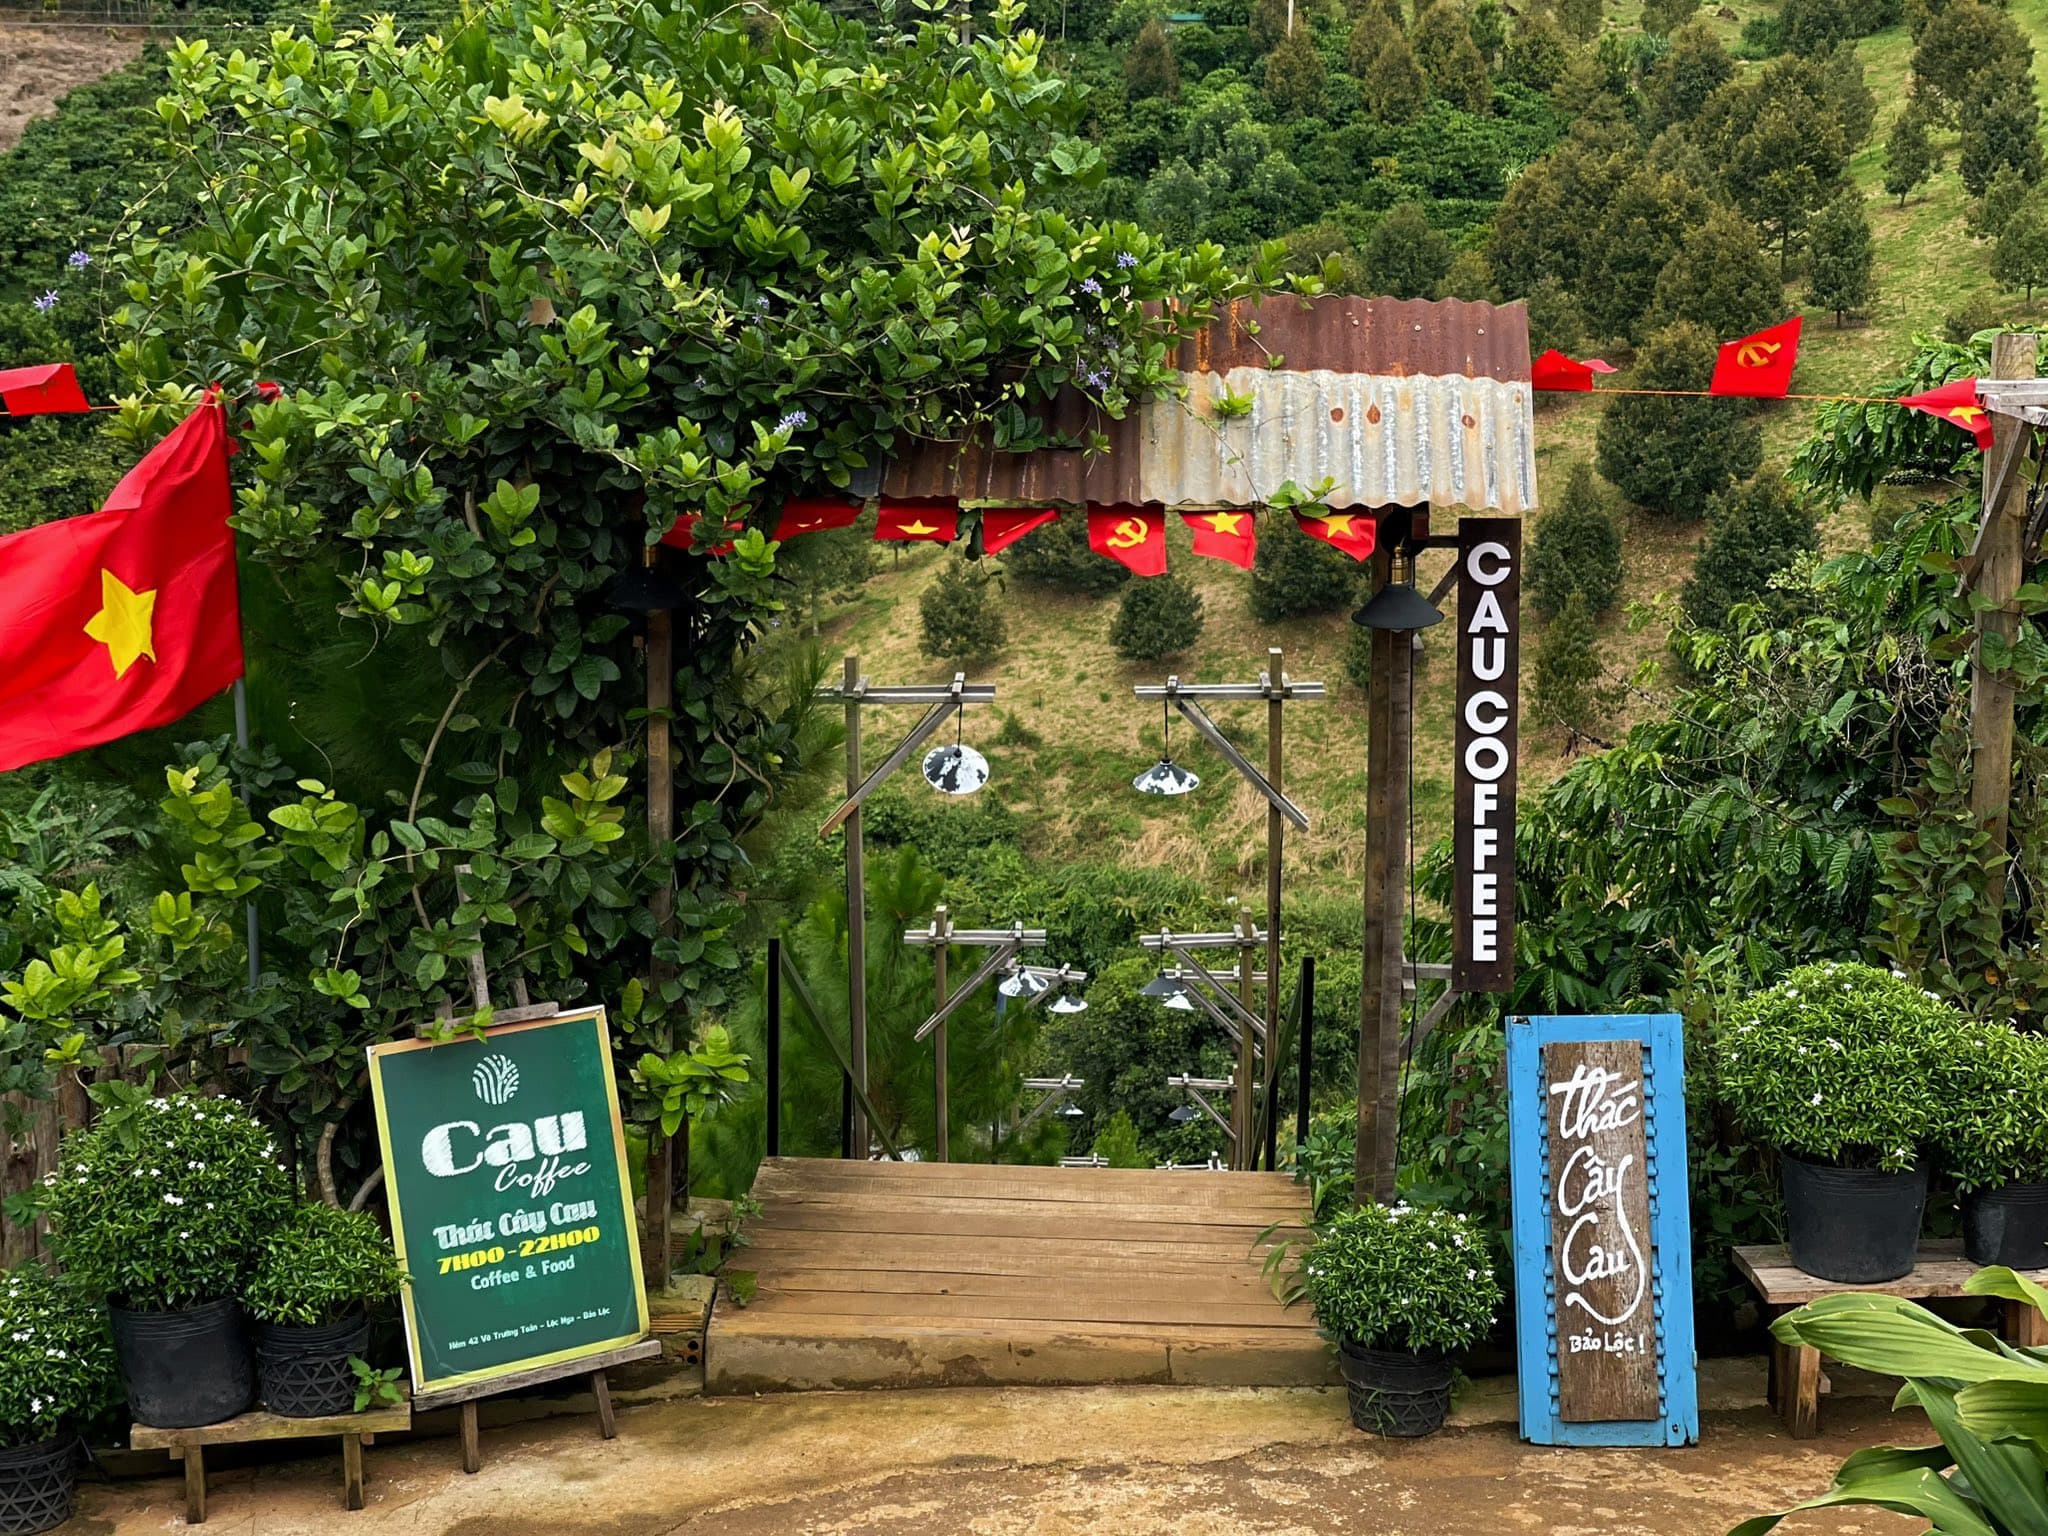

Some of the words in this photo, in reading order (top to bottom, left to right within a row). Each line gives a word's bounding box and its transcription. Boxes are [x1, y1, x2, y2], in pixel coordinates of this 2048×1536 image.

[1467, 542, 1512, 681] CAU
[1464, 690, 1509, 962] COFFEE
[421, 1110, 587, 1177] Cau
[494, 1156, 592, 1199] Coffee
[433, 1218, 496, 1250] Thác
[499, 1209, 547, 1234] Cây
[550, 1199, 598, 1226] Cau
[1562, 1211, 1631, 1286] Cau
[470, 1269, 520, 1290] Coffee
[525, 1265, 538, 1279] &
[541, 1254, 576, 1276] Food
[468, 1336, 479, 1346] 42
[1569, 1328, 1601, 1352] Bảo
[1604, 1334, 1635, 1358] Lộc
